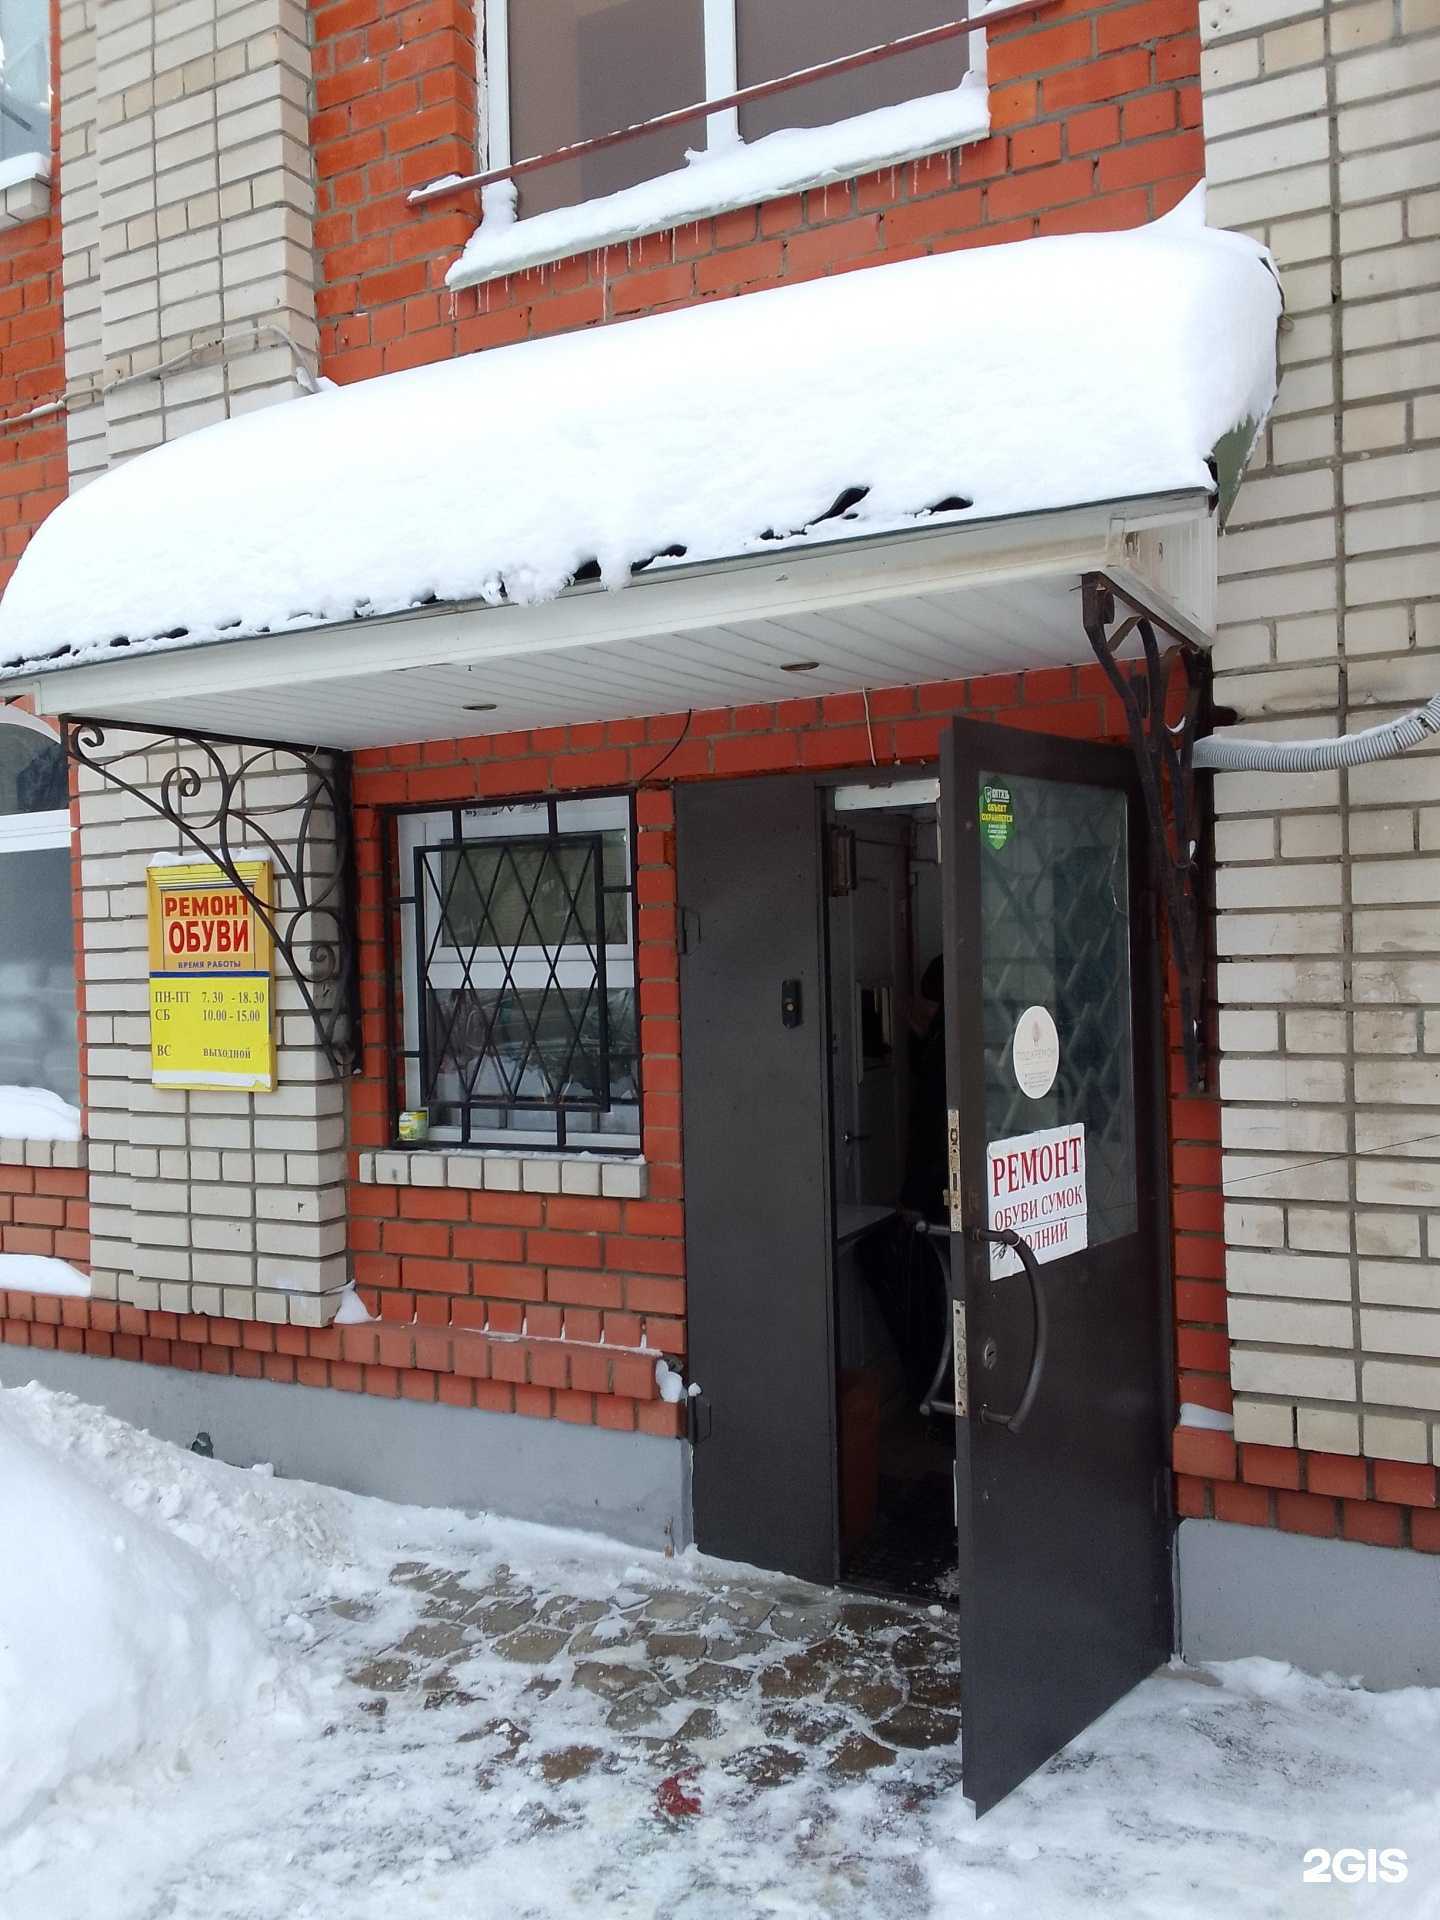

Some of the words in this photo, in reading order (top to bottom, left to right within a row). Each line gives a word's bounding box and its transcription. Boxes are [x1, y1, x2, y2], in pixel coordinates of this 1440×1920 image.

[164, 895, 249, 917] РЕМОНТ
[169, 919, 249, 954] ОБУВИ
[178, 961, 205, 969] ВРЕМЯ
[207, 960, 241, 968] РАБОТЫ
[155, 991, 191, 1003] ПН-ПТ
[155, 1008, 171, 1021] СБ
[203, 1009, 227, 1022] 10.00
[236, 1010, 260, 1022] 15.00
[157, 1044, 172, 1057] ВС
[992, 1137, 1082, 1197] РЕМОНТ
[995, 1199, 1038, 1231] ОБУВИ
[1041, 1185, 1083, 1215] СУМОК
[1013, 1217, 1068, 1259] ОЛНИЙ
